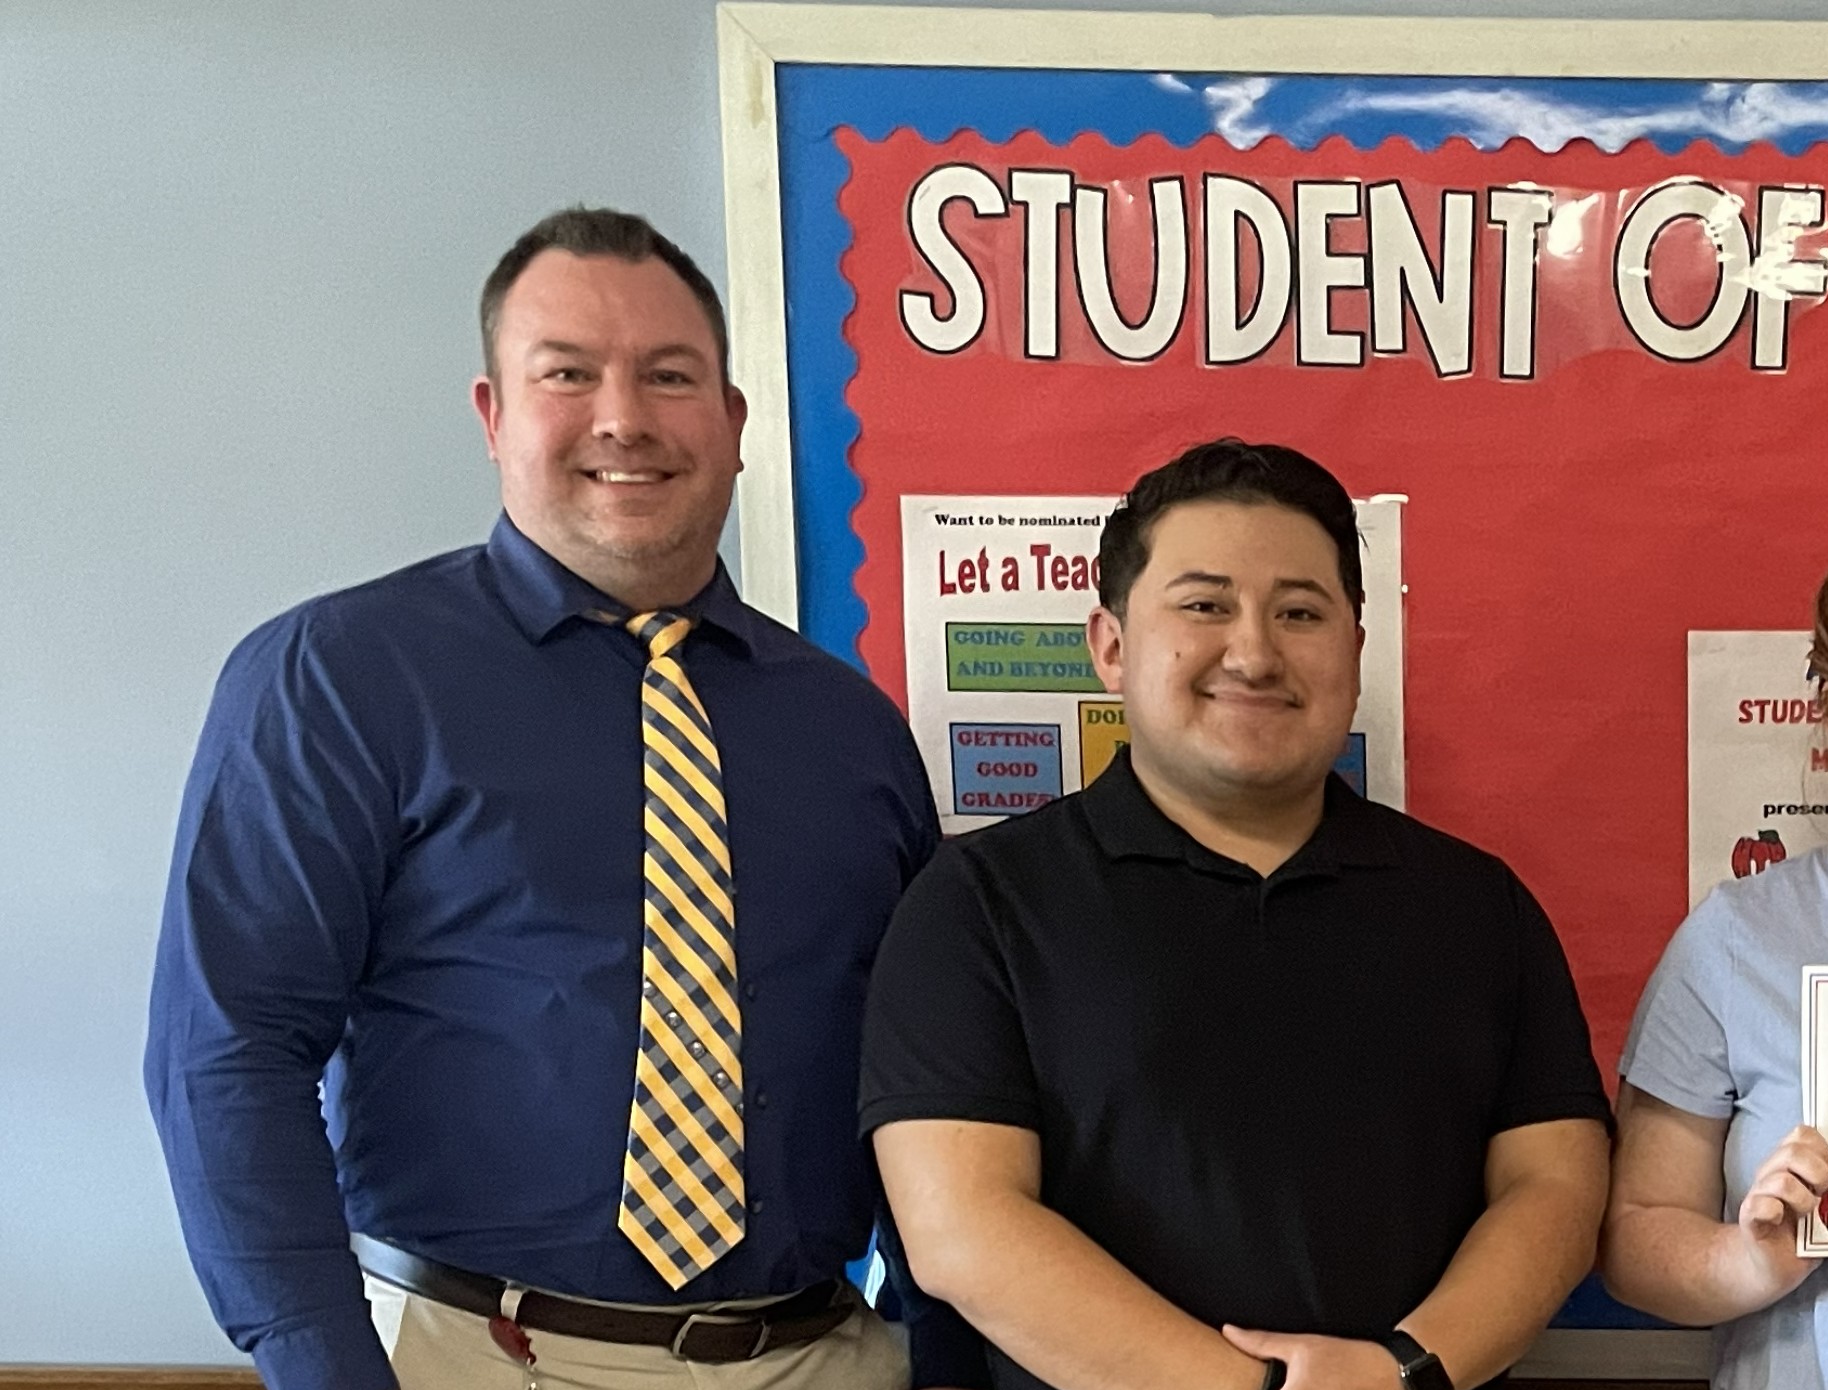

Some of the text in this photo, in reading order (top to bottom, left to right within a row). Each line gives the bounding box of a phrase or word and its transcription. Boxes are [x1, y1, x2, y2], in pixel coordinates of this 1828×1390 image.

[899, 164, 1551, 380] STUDENT
[935, 514, 974, 526] Want
[979, 516, 994, 526] to
[999, 515, 1015, 526] be
[1019, 515, 1100, 526] nominated
[939, 543, 1101, 597] Let a Teac
[954, 631, 1086, 647] GOING ABO
[957, 661, 1004, 677] AND
[1738, 699, 1824, 725] STUDE
[957, 731, 1055, 747] GETTING
[976, 761, 1038, 777] GOOD
